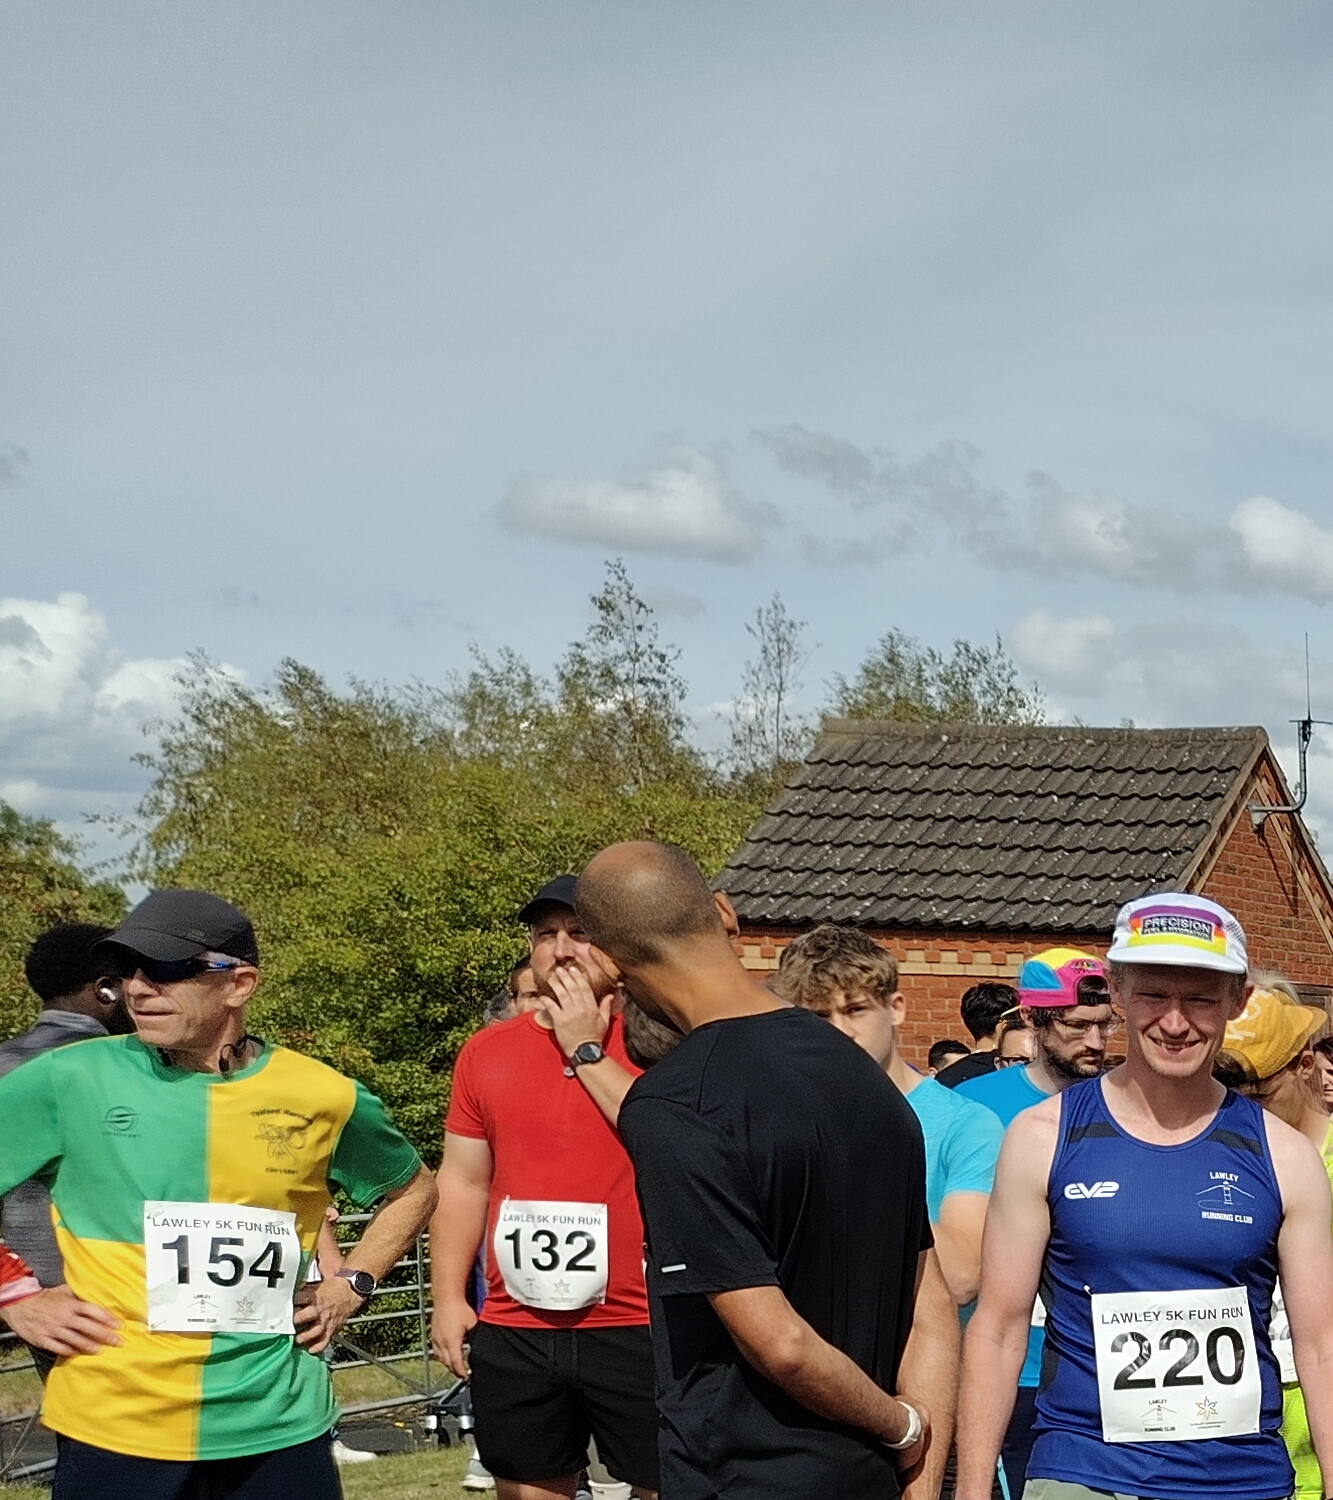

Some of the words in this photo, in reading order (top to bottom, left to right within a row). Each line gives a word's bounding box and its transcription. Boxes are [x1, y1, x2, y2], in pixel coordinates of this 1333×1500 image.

[1144, 917, 1211, 934] PRECISION
[1209, 1171, 1239, 1182] LAWLEY
[152, 1217, 211, 1229] LAWLEY
[215, 1220, 233, 1230] 5K
[237, 1221, 262, 1233] FUN
[265, 1224, 290, 1236] RUN
[503, 1214, 534, 1223] LAWLEY
[537, 1215, 549, 1223] 5K
[553, 1215, 574, 1224] FUN
[578, 1216, 601, 1226] RUN
[1201, 1211, 1234, 1222] RUNNING
[1234, 1213, 1253, 1224] CLUB
[504, 1228, 597, 1272] 132
[162, 1235, 286, 1289] 154
[1101, 1311, 1161, 1325] LAWLEY
[1166, 1310, 1184, 1321] 5K
[1189, 1309, 1217, 1320] FUN
[1222, 1306, 1244, 1319] RUN
[1111, 1326, 1245, 1391] 220
